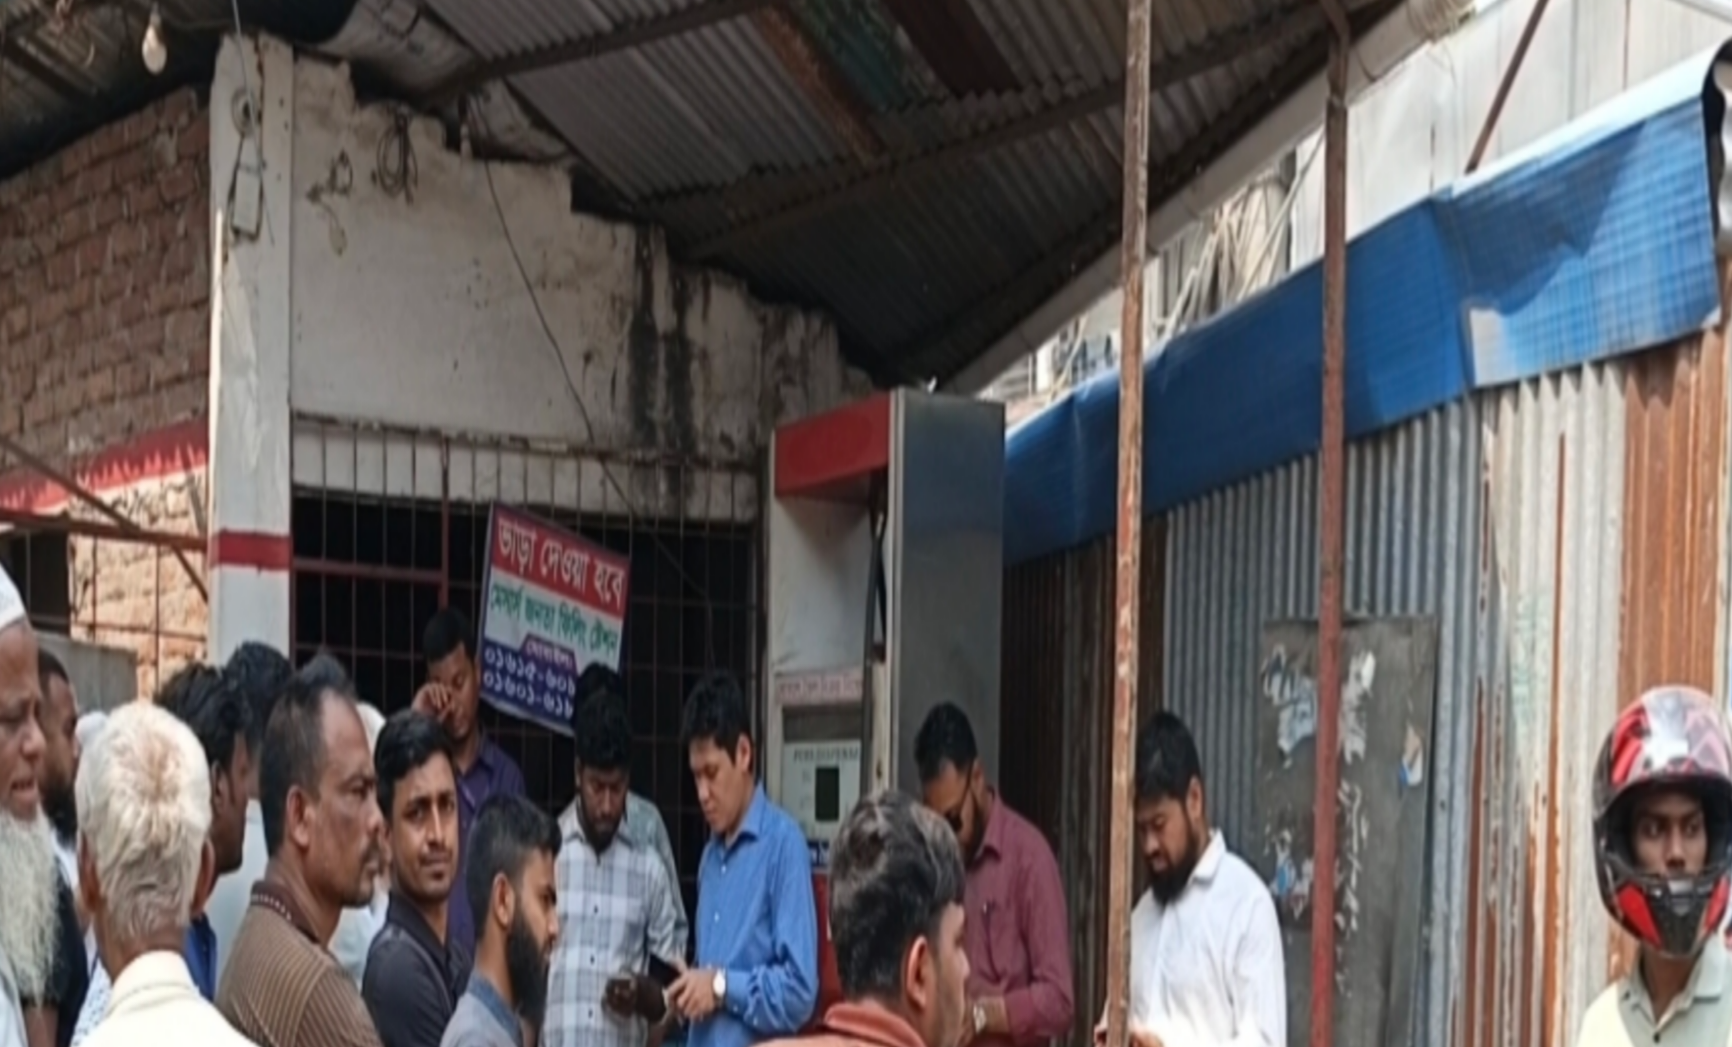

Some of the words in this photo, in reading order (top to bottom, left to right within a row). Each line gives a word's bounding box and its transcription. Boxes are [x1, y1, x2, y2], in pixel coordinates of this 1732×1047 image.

[498, 516, 537, 578] ভাড়া
[540, 539, 589, 596] দেওয়া
[594, 559, 625, 609] হবে
